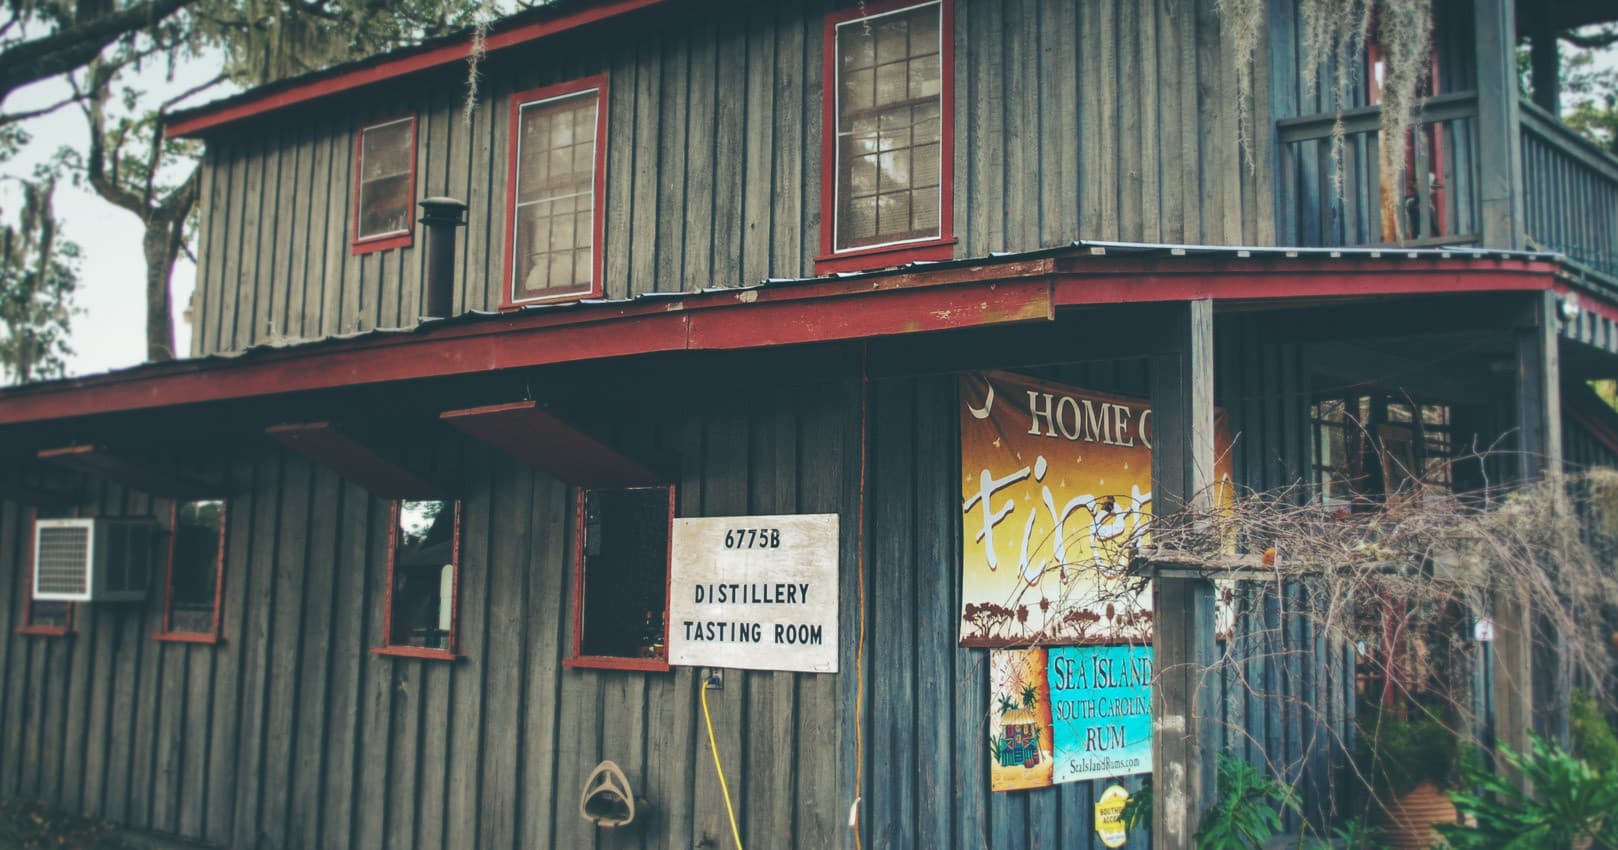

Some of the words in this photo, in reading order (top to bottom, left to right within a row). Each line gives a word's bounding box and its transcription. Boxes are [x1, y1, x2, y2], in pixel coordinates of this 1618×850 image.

[1026, 390, 1134, 448] HOME
[725, 528, 780, 549] 6775B
[695, 584, 809, 604] DISTILLERY
[684, 621, 761, 643] TASTING
[774, 623, 822, 645] ROOM
[1054, 655, 1089, 691] SEA
[1092, 654, 1153, 689] ISLAND
[1057, 700, 1095, 721] SOUTH
[1086, 725, 1126, 752] RUM
[1070, 756, 1140, 774] SeaIslandRums.com
